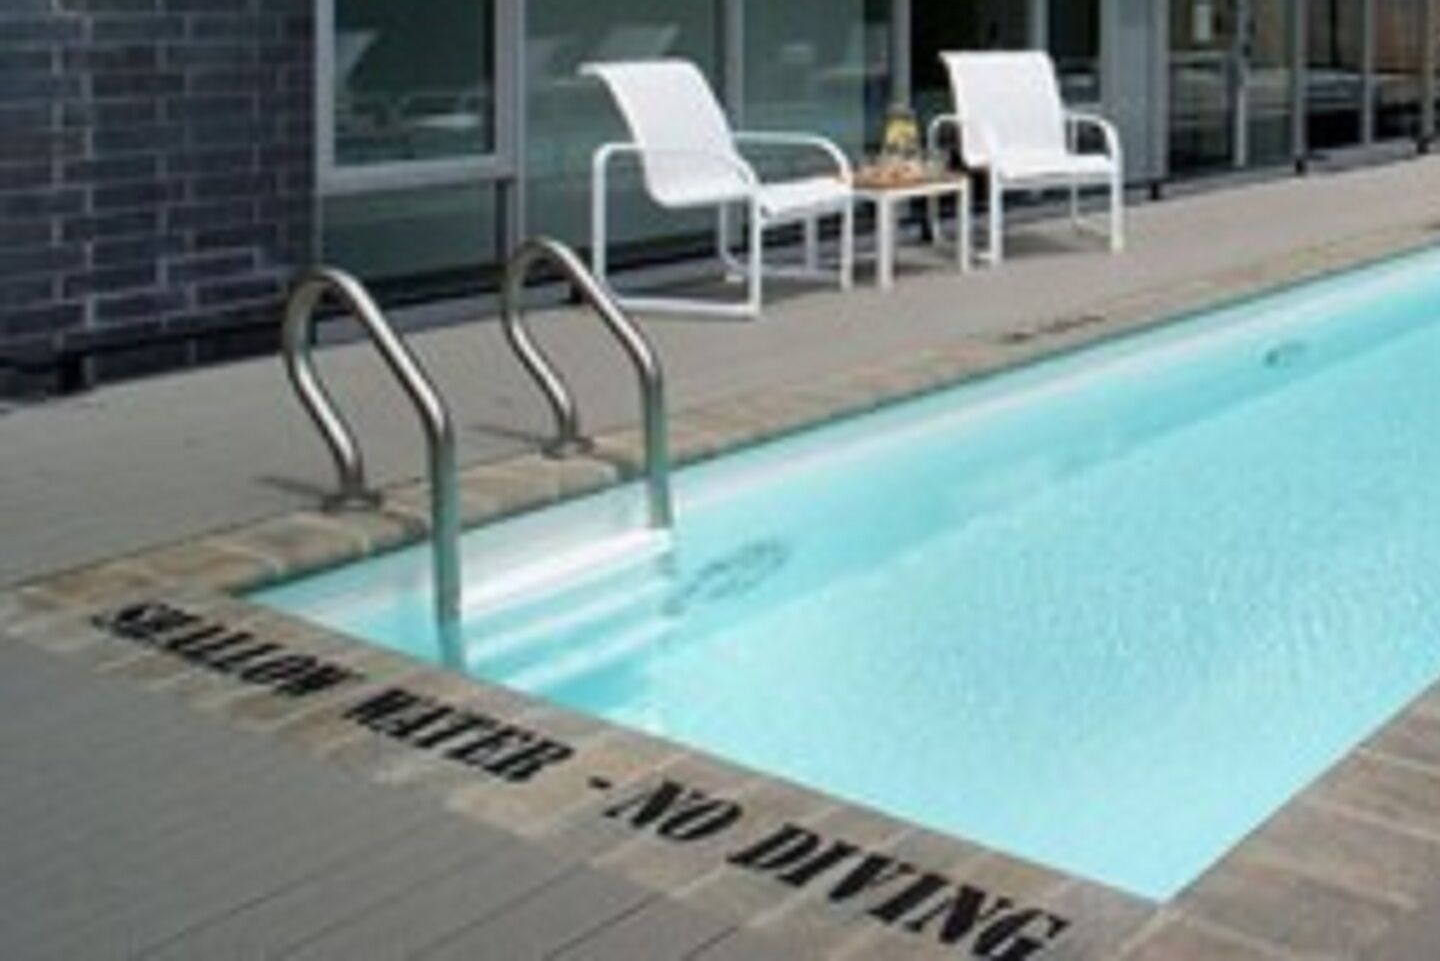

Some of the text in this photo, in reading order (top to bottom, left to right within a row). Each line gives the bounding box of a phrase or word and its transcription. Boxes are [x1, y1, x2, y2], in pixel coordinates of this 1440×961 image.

[342, 688, 575, 782] WATER
[605, 781, 743, 840] NO
[726, 822, 1070, 961] DIVING
